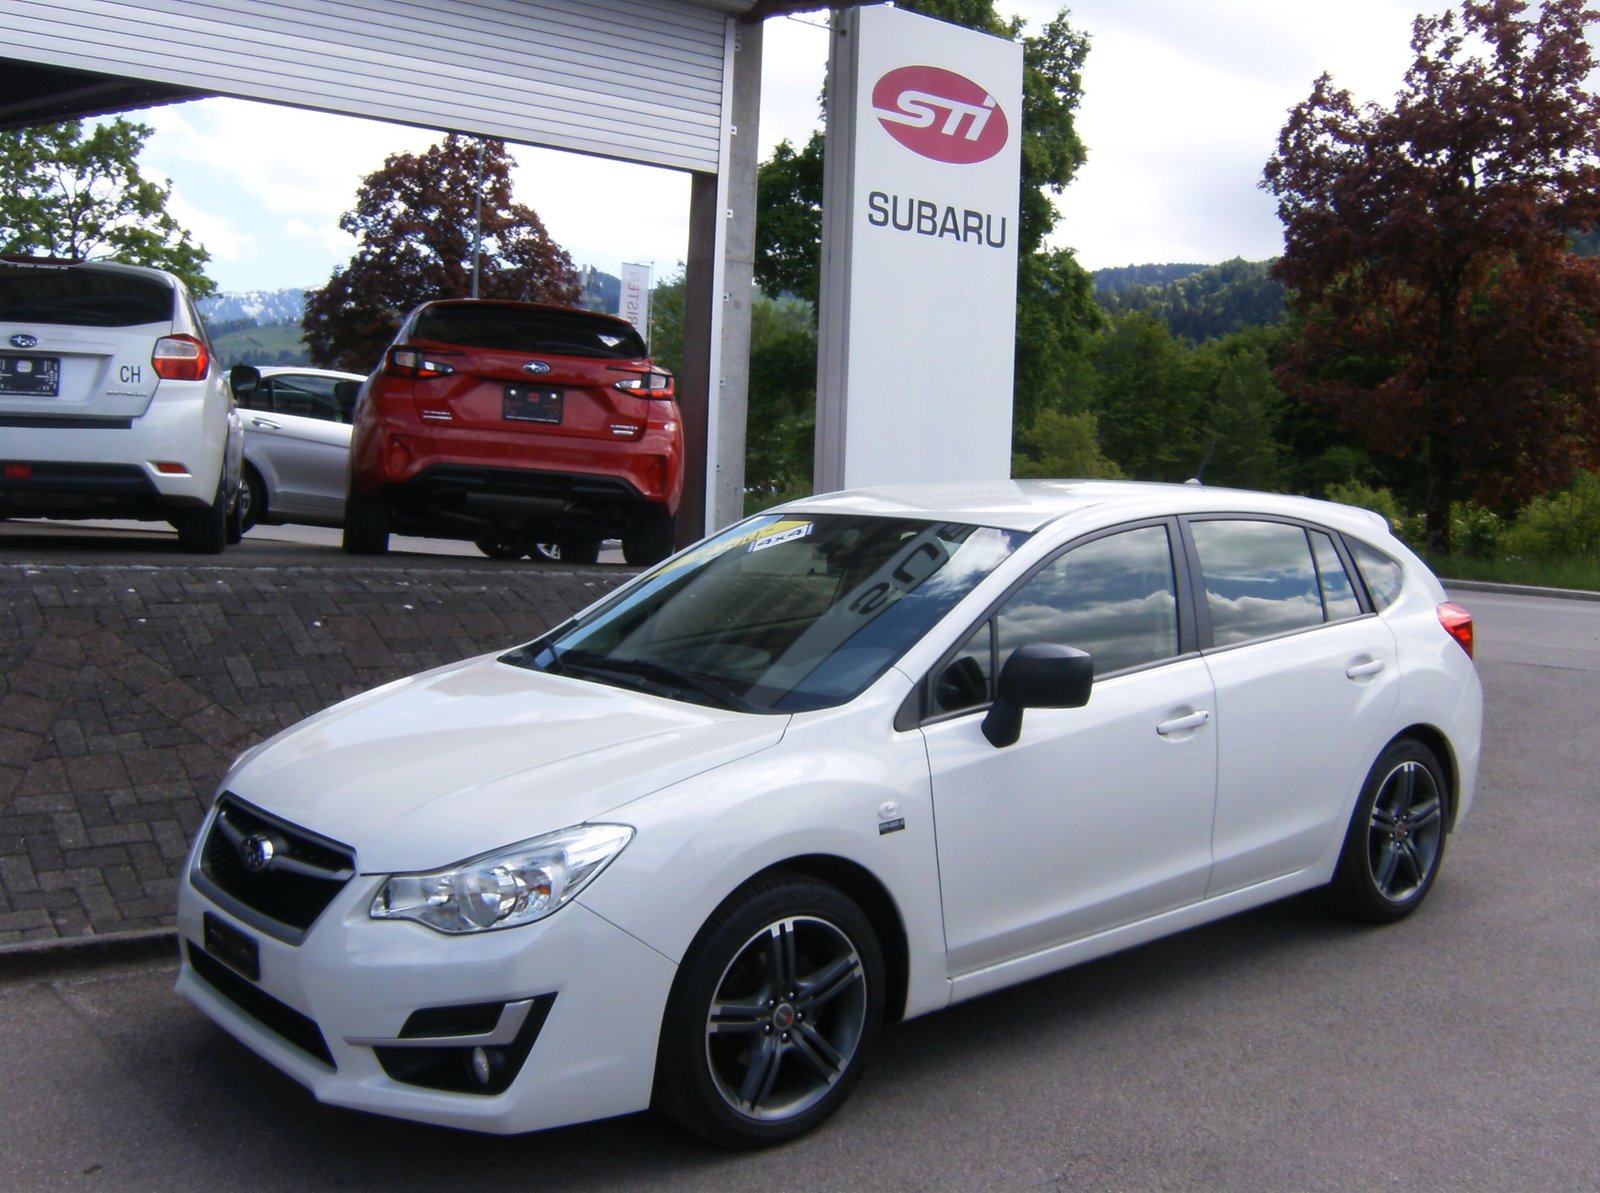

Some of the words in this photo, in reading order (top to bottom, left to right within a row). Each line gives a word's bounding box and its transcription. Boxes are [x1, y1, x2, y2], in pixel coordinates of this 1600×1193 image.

[868, 190, 1007, 249] SUBARU
[120, 365, 141, 383] CH
[756, 527, 804, 547] 4x4
